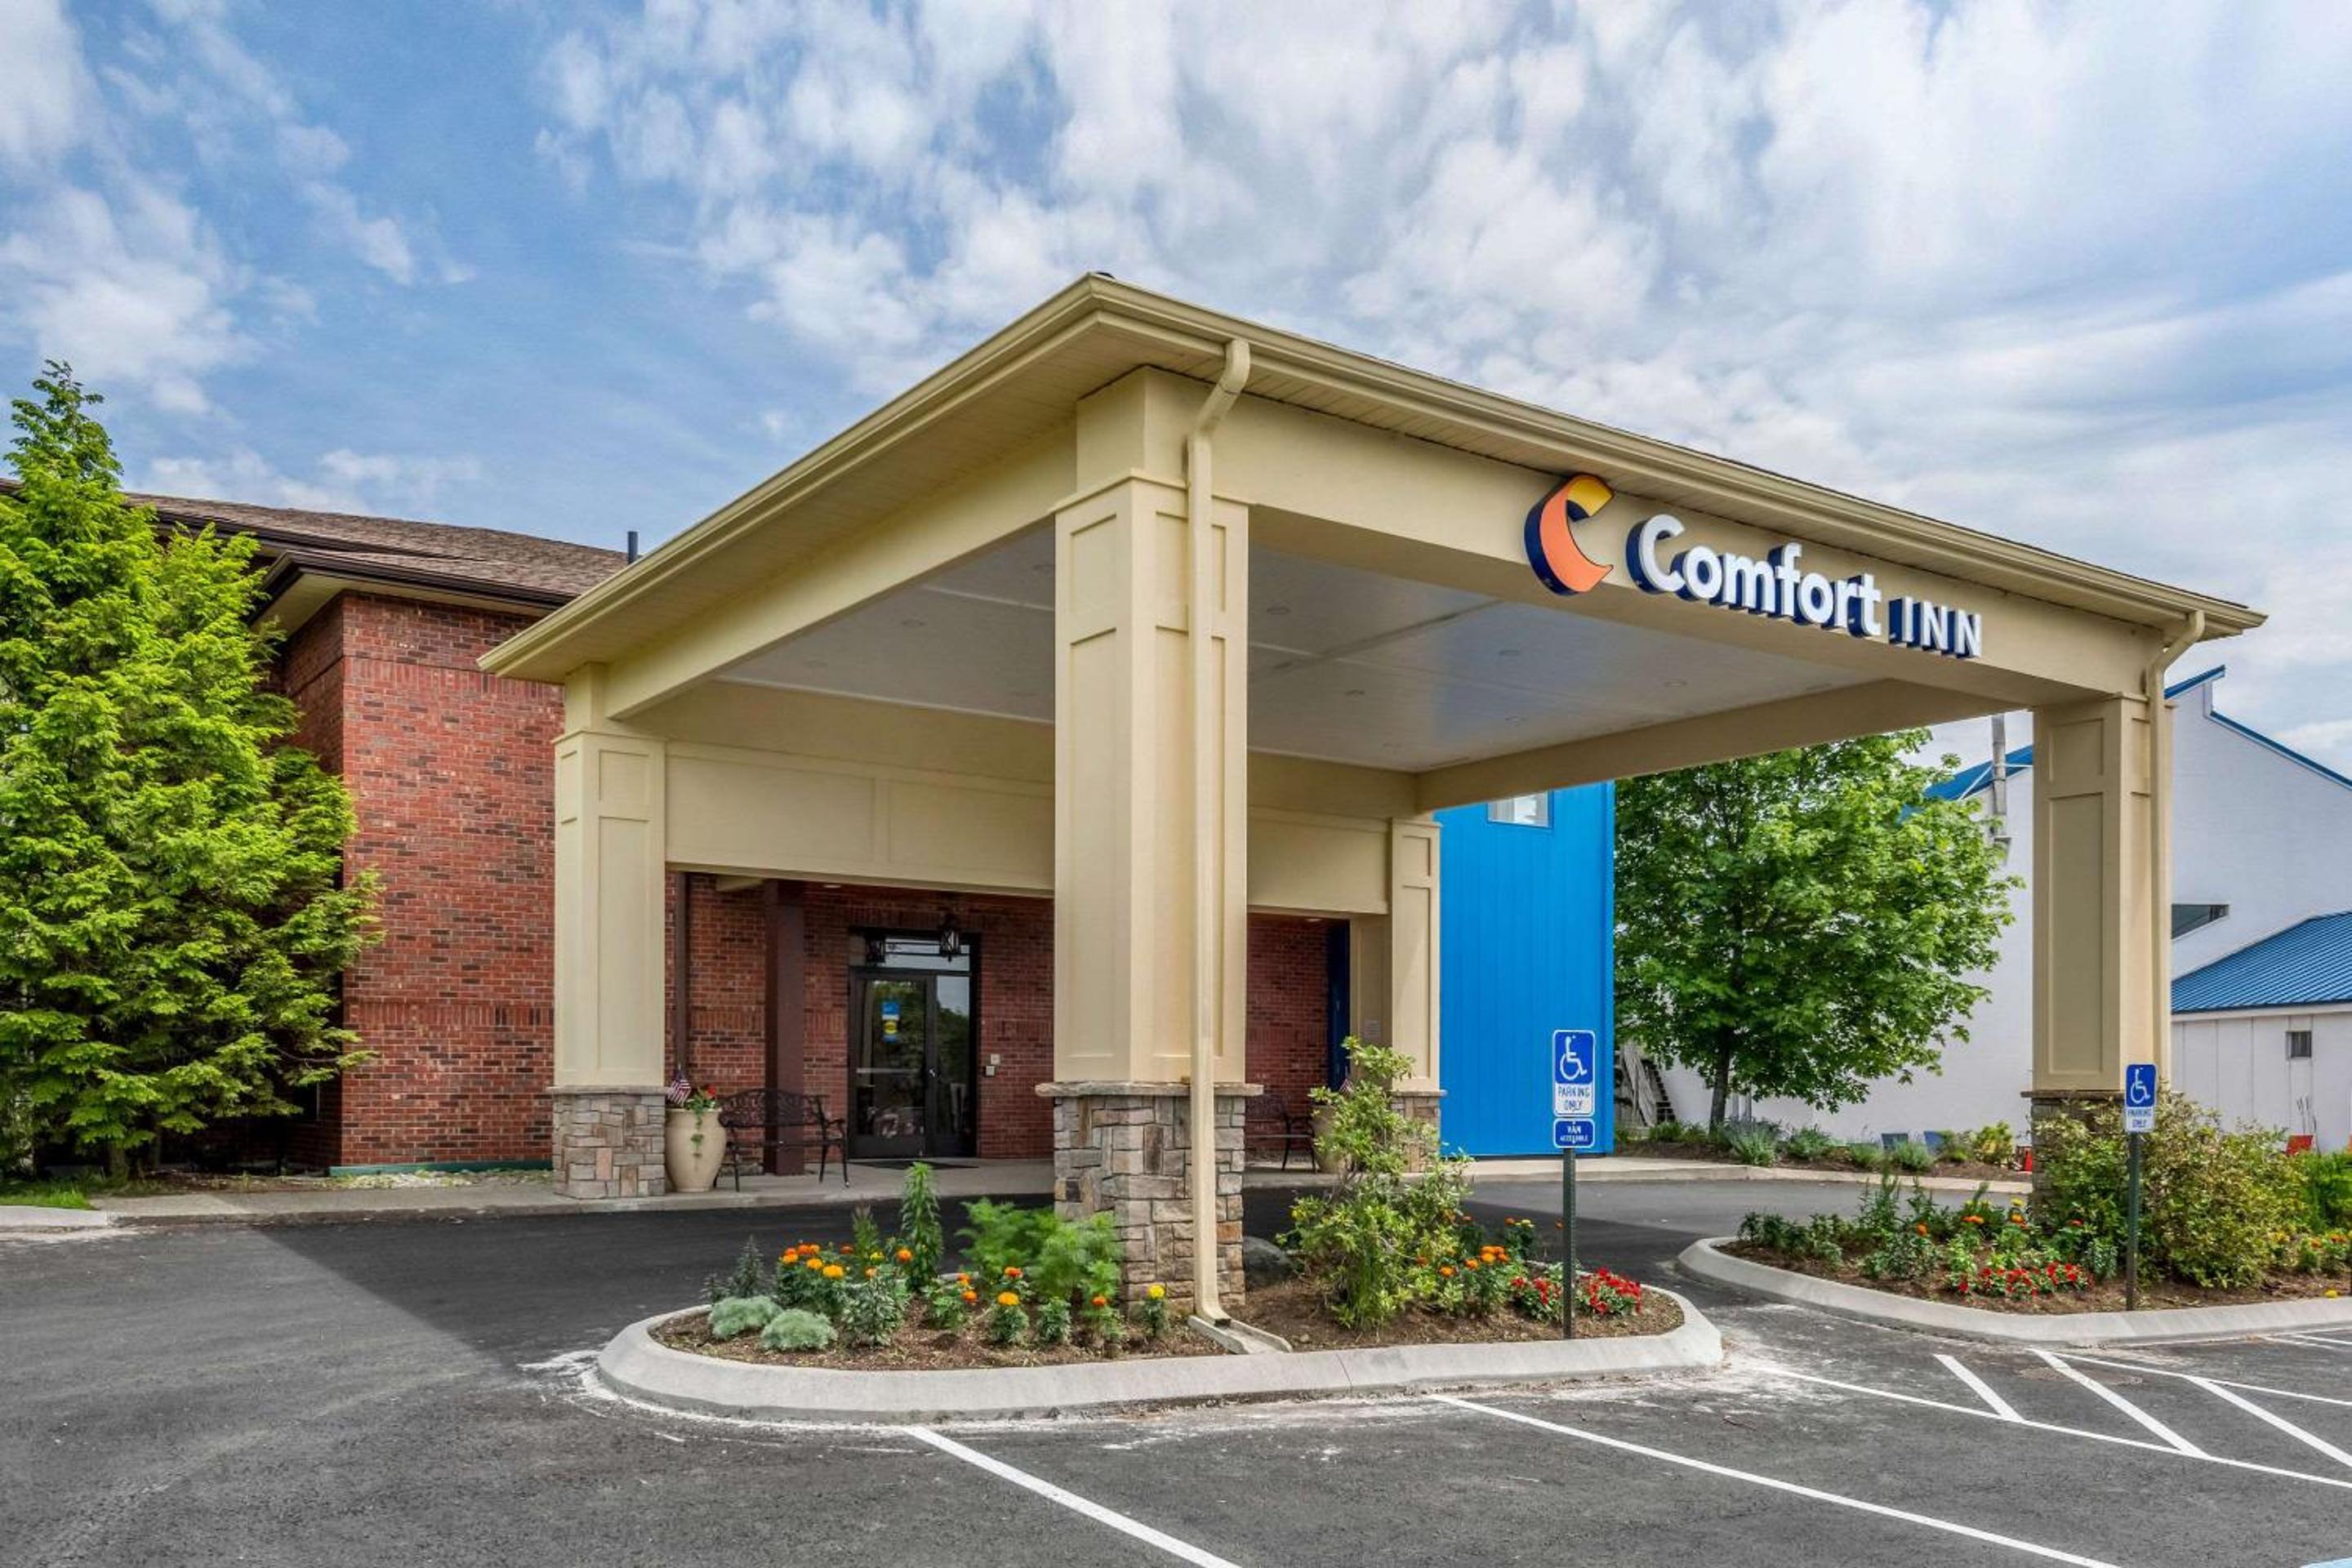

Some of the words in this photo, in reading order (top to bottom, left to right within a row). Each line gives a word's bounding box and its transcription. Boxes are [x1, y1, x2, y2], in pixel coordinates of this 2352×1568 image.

[1625, 513, 1882, 637] Comfort
[1888, 595, 1982, 658] INN
[1558, 1086, 1591, 1098] PARKING
